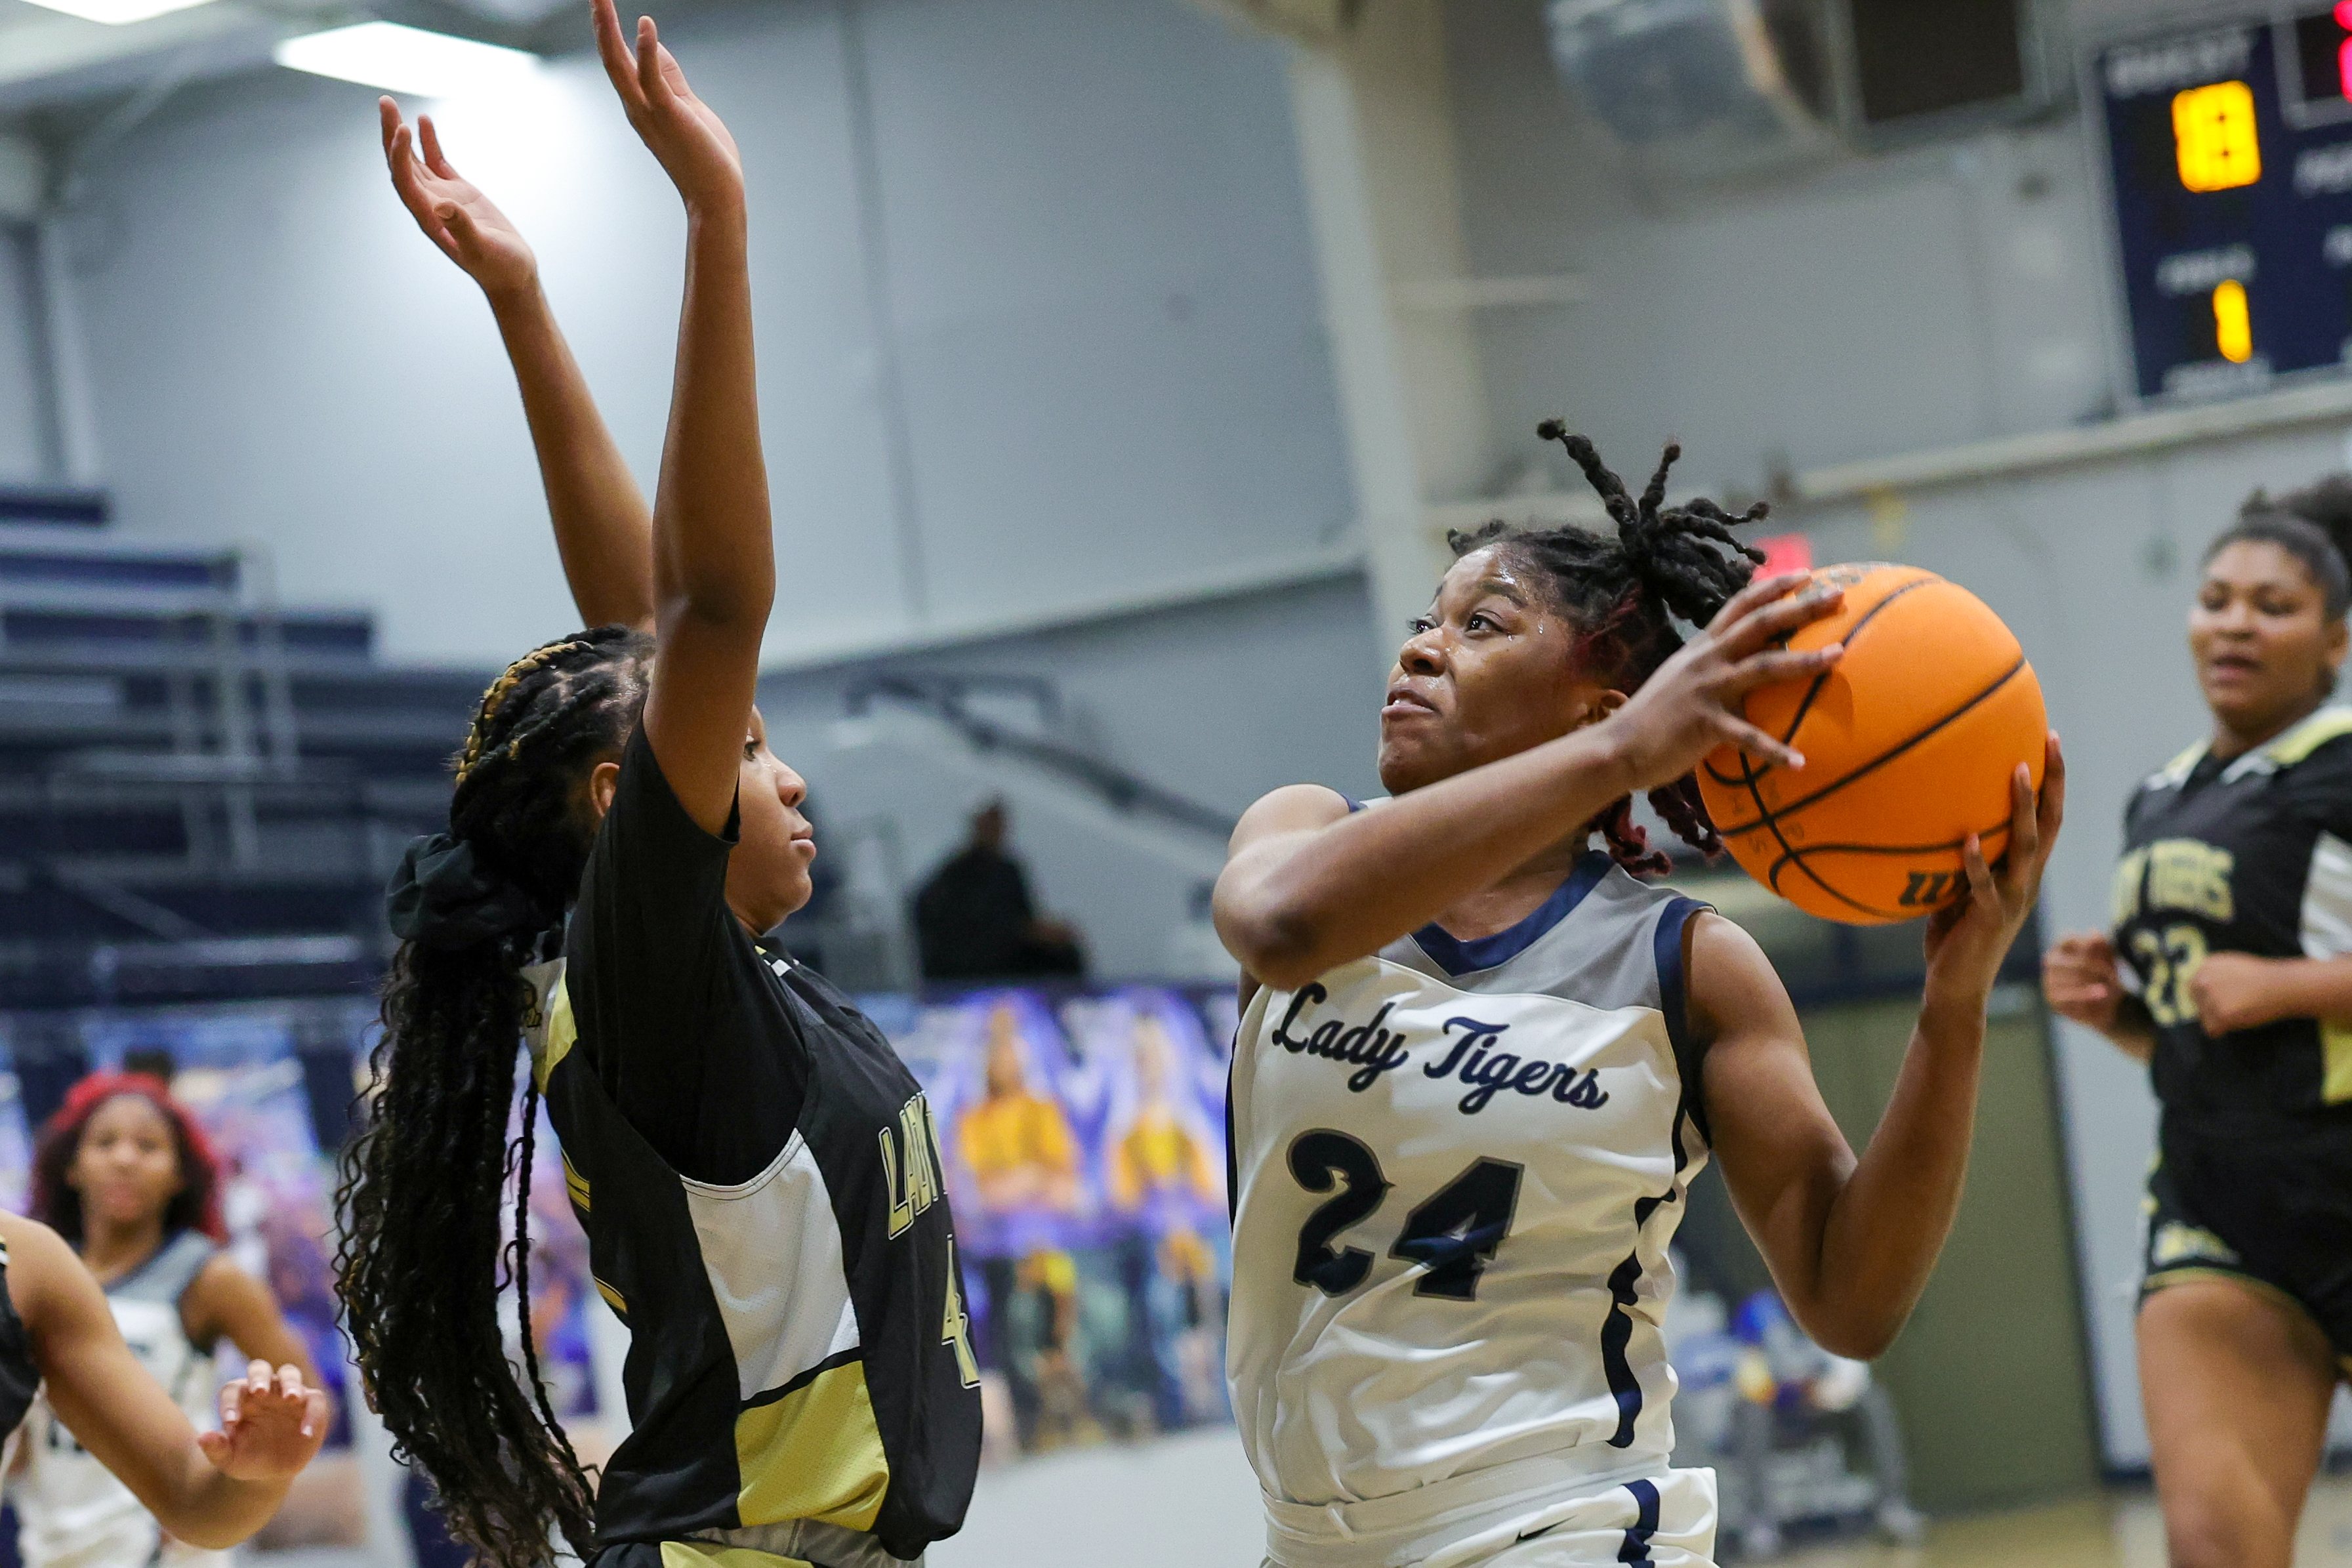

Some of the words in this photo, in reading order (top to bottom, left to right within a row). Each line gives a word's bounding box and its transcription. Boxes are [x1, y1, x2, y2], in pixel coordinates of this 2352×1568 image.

[2212, 279, 2252, 363] 1
[1271, 981, 1409, 1092] Lady
[1423, 1016, 1609, 1115] Tigers
[1286, 1127, 1525, 1302] 24
[941, 1233, 981, 1390] 4
